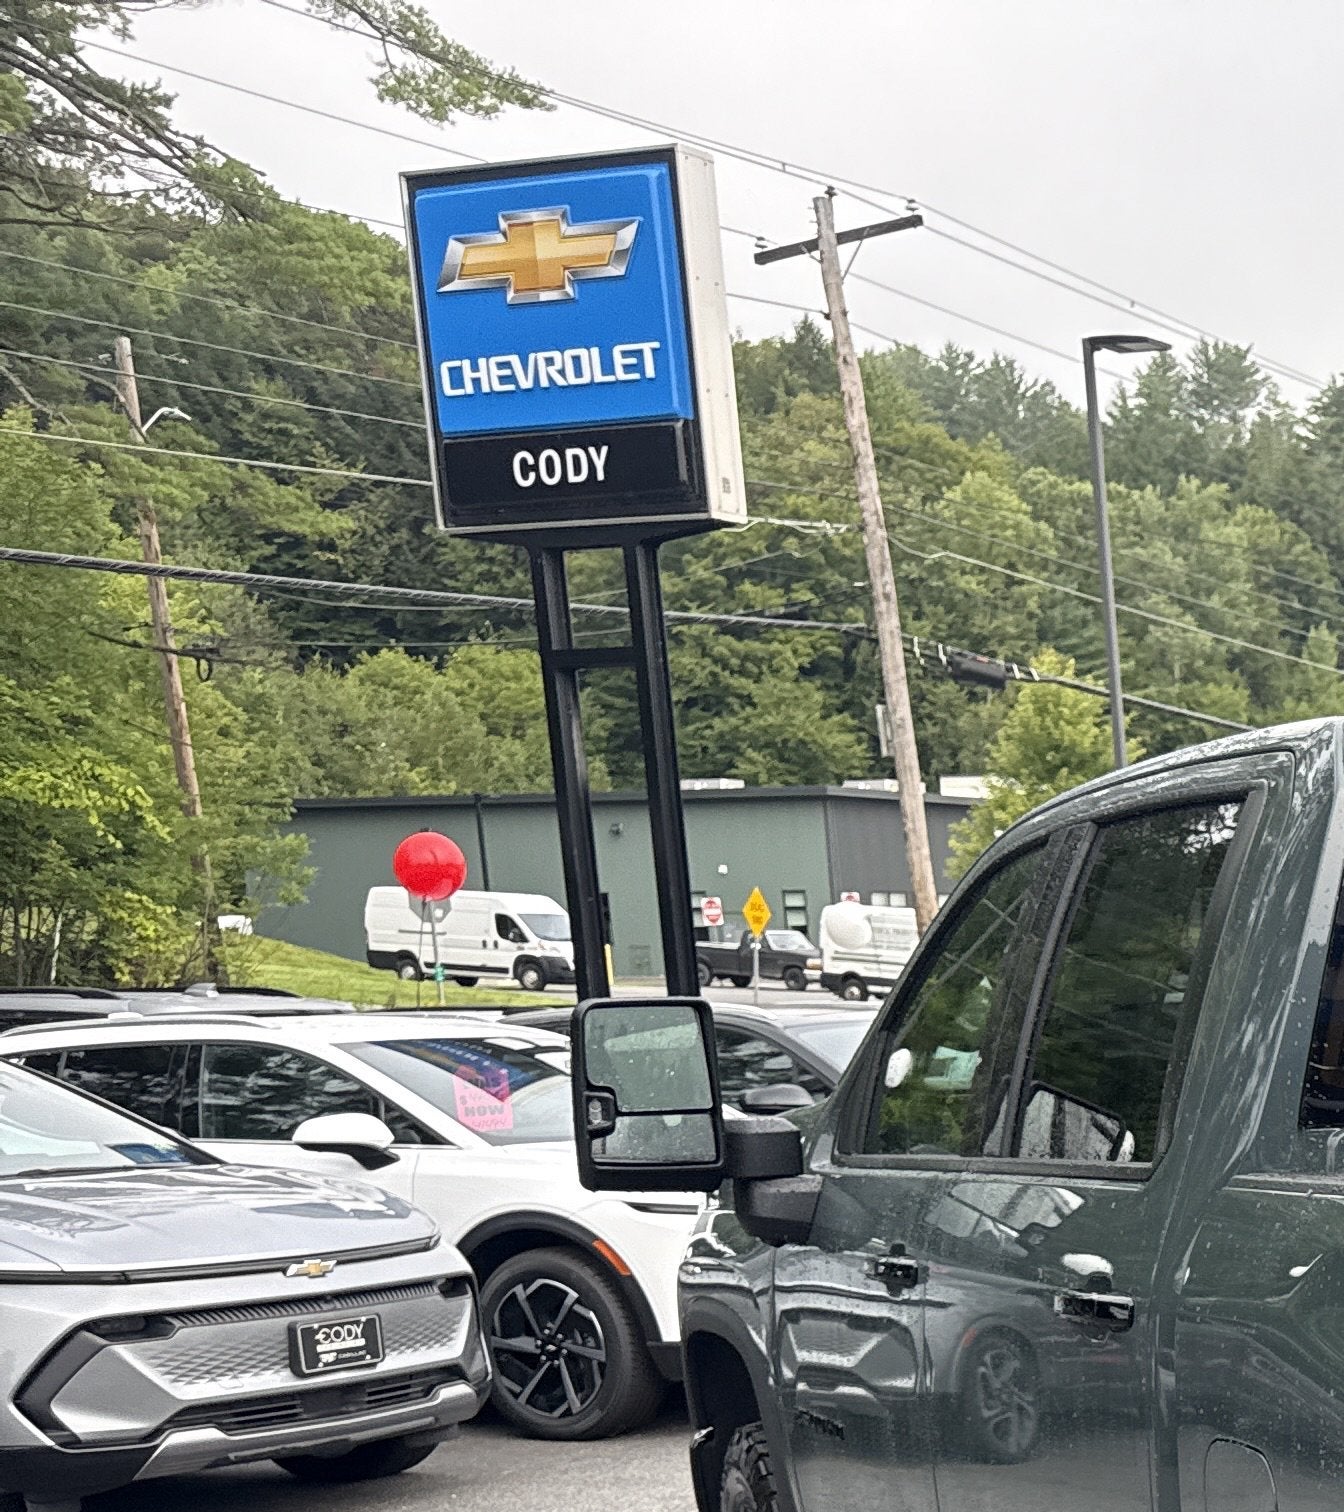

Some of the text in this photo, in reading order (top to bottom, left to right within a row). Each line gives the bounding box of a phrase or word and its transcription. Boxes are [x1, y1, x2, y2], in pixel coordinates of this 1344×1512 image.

[440, 341, 660, 397] CHEVROLET
[512, 445, 609, 488] CODY
[464, 1104, 505, 1117] NOW
[314, 1323, 364, 1344] CODY
